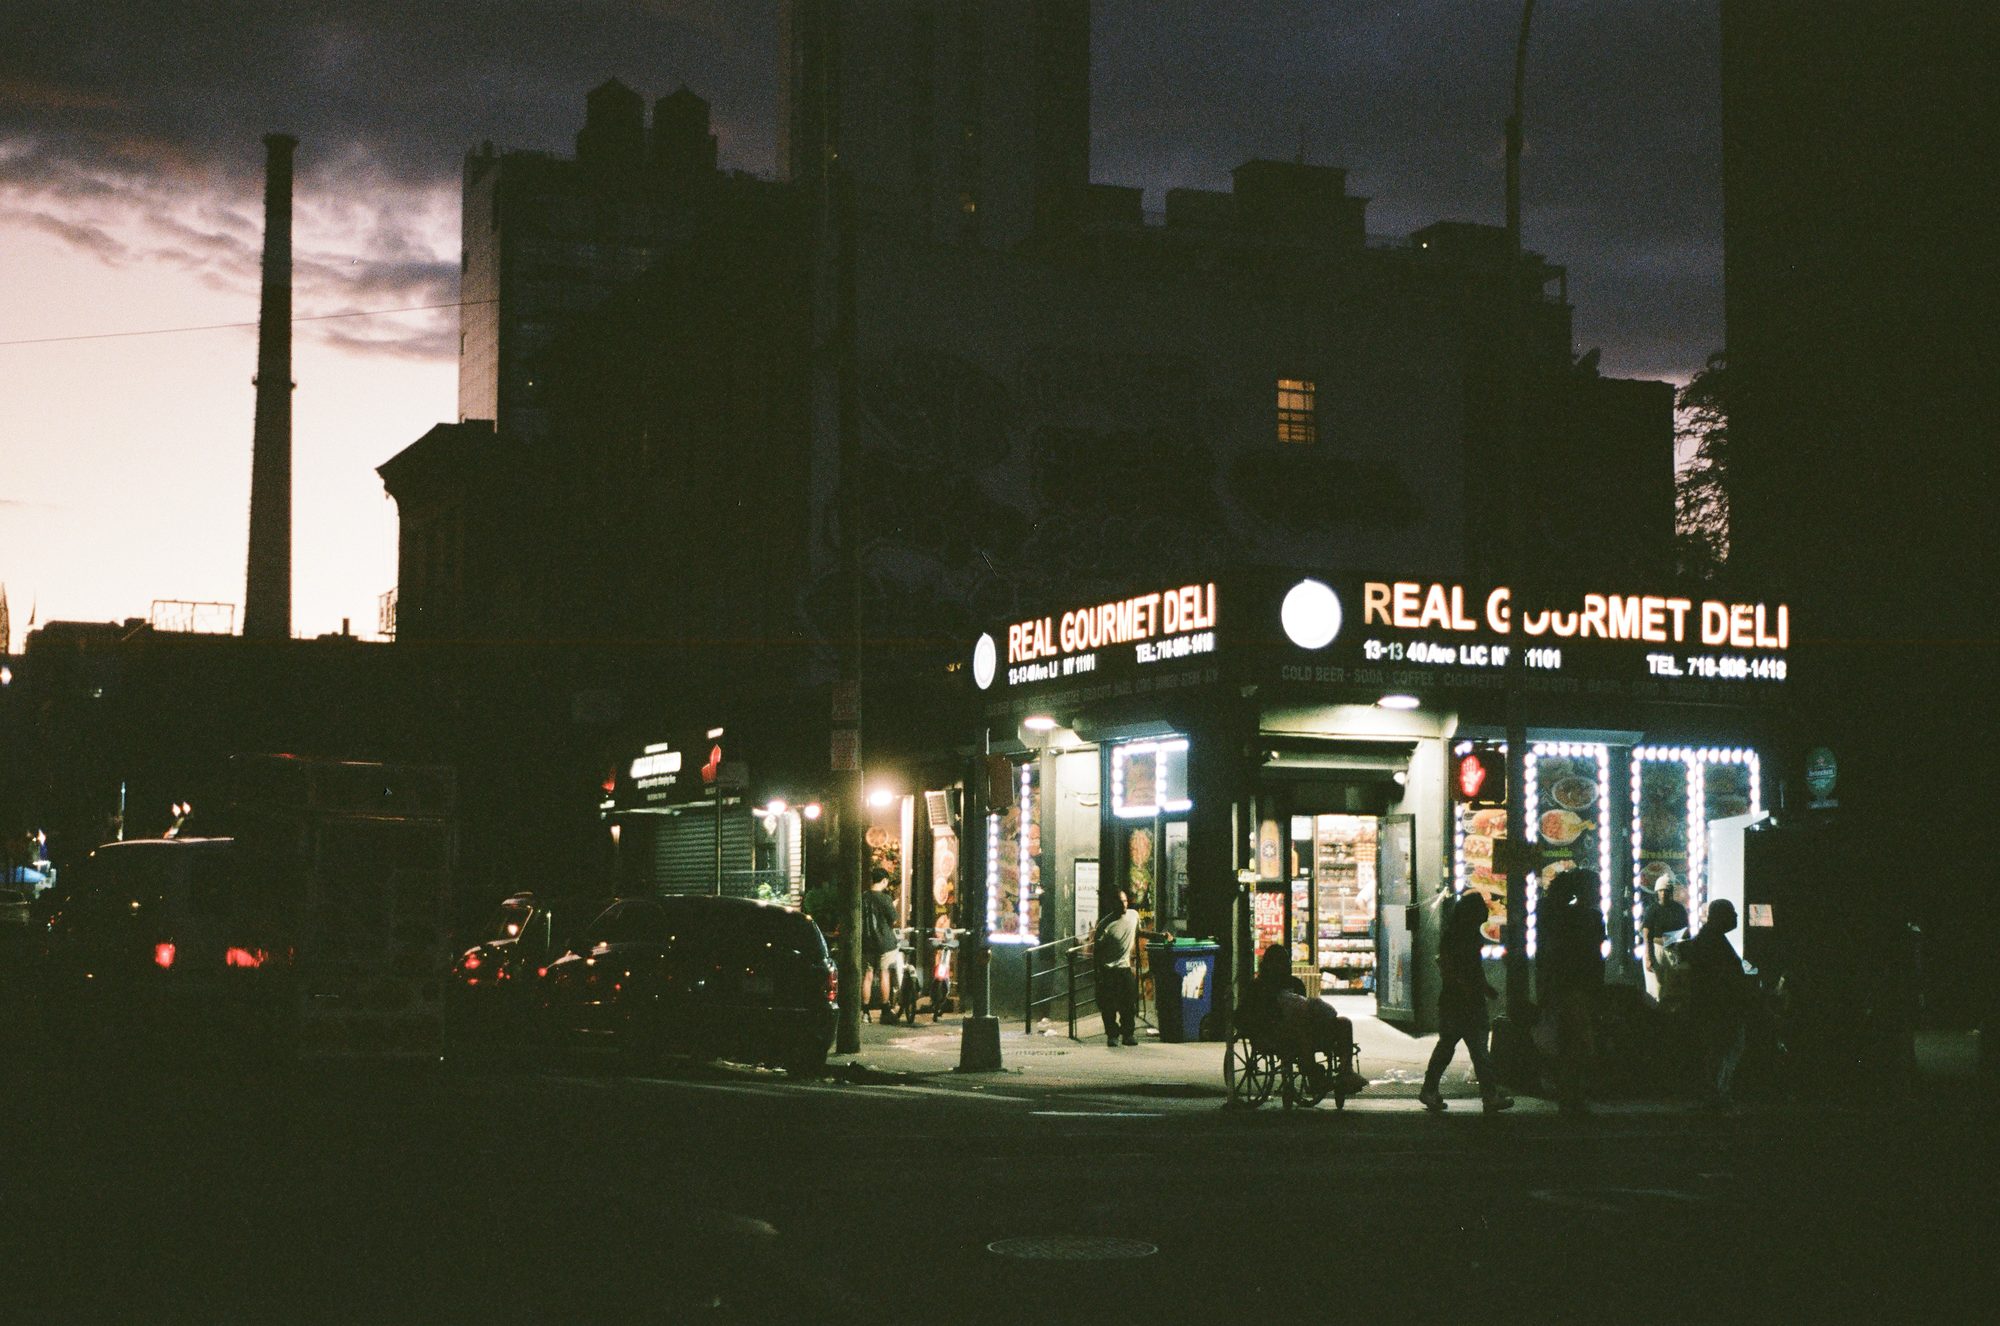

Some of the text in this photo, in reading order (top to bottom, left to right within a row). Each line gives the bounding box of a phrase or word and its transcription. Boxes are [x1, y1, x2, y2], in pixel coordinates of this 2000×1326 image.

[1008, 583, 1217, 664] REAL GOURMET DELI
[1363, 580, 1478, 631] REAL
[1700, 599, 1789, 650] DELI
[1363, 639, 1404, 662] 13-13
[1459, 644, 1489, 667] LIC
[1315, 666, 1344, 683] BEER
[1255, 913, 1283, 926] DELI
